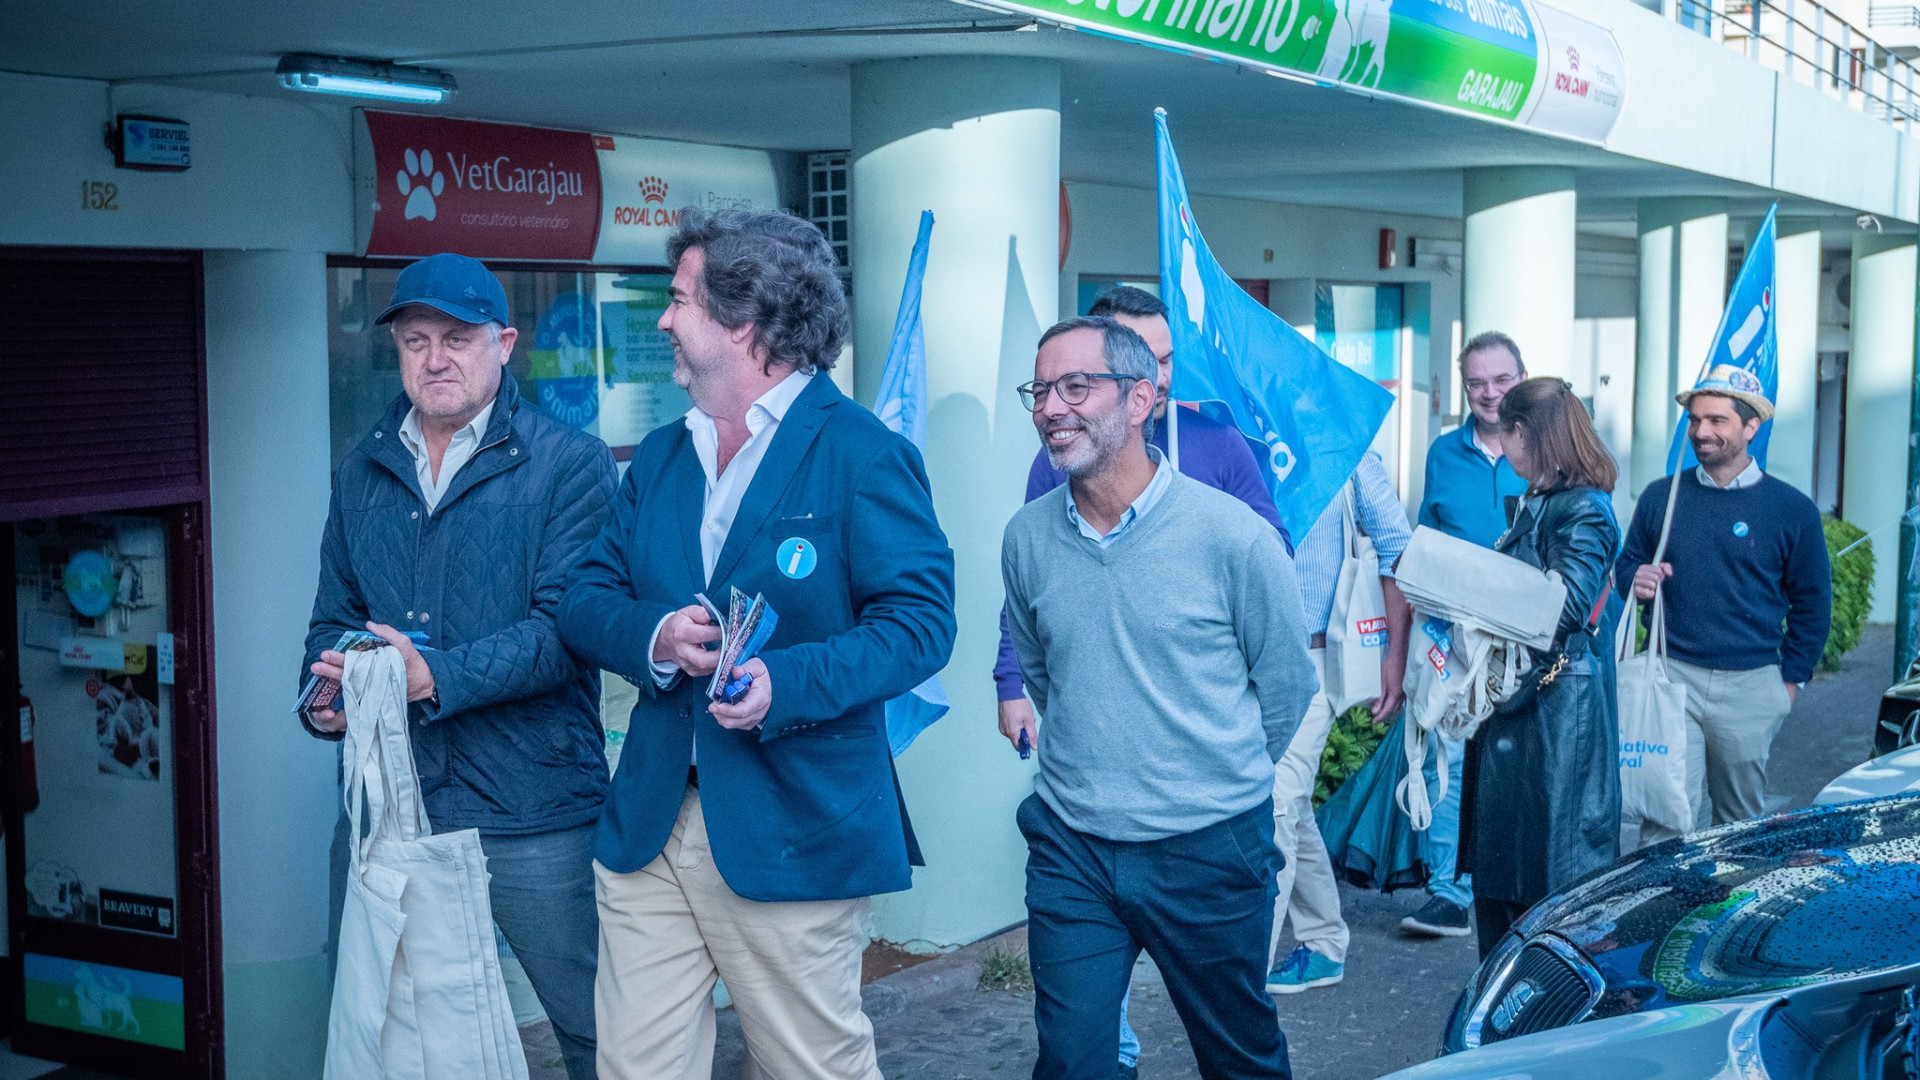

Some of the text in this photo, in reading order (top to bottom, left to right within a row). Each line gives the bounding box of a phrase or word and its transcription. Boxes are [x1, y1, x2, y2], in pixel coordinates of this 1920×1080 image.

[1457, 68, 1524, 113] GARAJAU
[149, 127, 190, 142] SERVIEL
[447, 152, 583, 205] VetGarajau
[81, 180, 118, 210] 152
[461, 211, 569, 229] consultório veterinário
[614, 206, 680, 227] ROYAL CAN
[1619, 740, 1669, 755] iativa
[103, 898, 155, 918] BRAVERY
